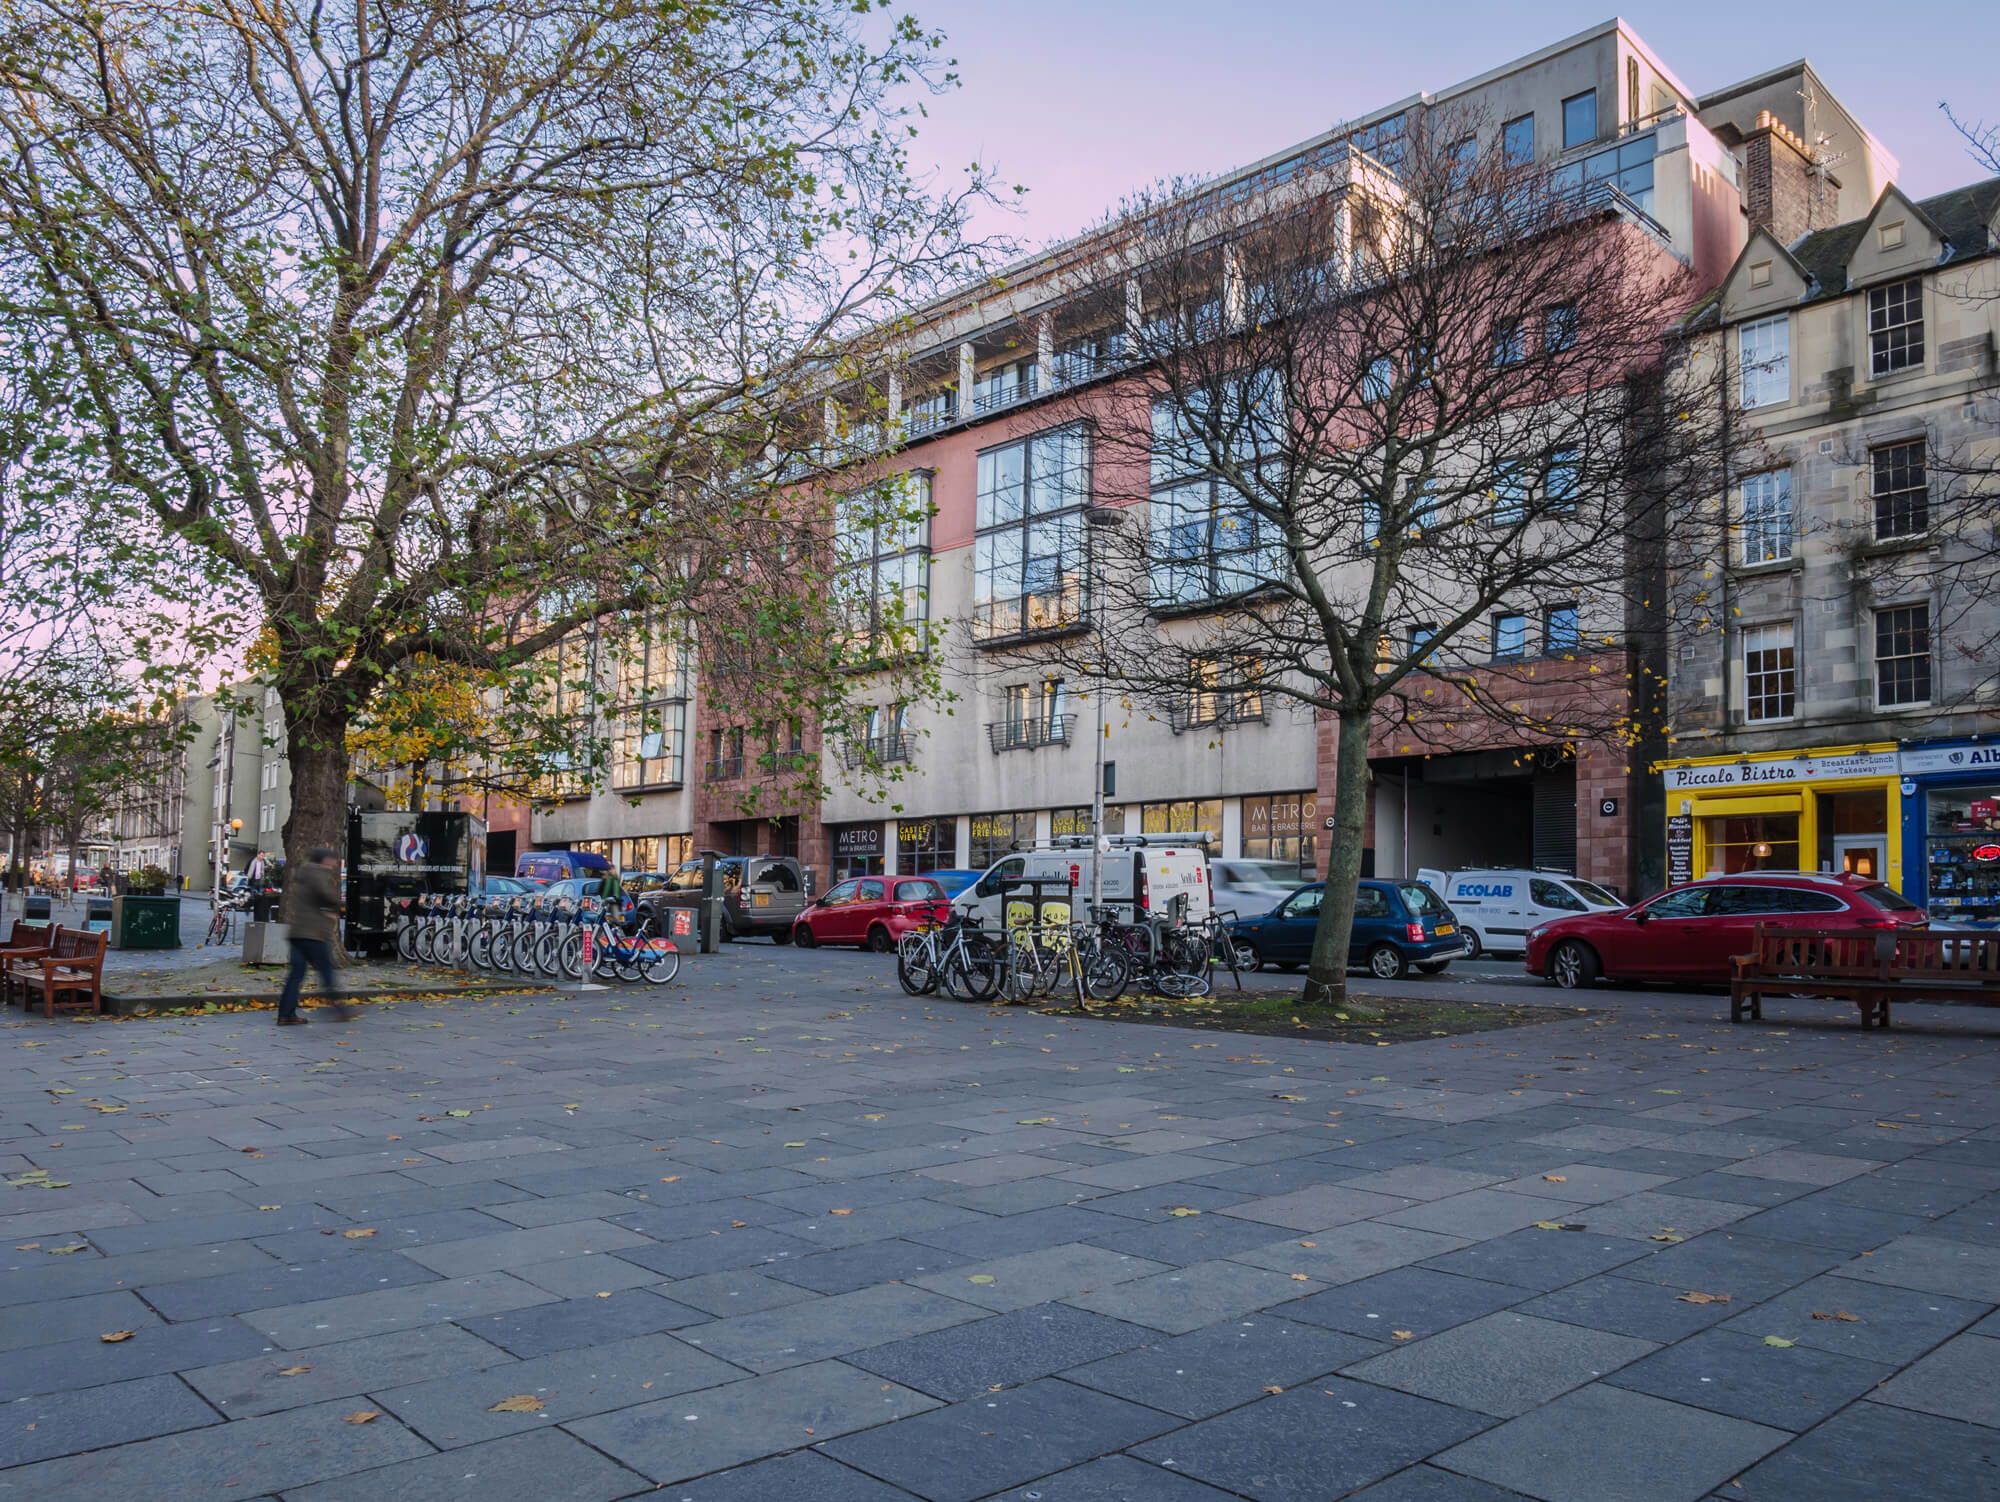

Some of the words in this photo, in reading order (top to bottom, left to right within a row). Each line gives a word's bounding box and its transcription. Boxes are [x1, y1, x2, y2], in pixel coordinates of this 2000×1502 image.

[1839, 766, 1877, 774] Takeaway
[1676, 768, 1735, 786] Piccolo
[1741, 765, 1796, 781] Bistro
[1252, 802, 1316, 821] METRO
[972, 821, 1001, 829] FAMILY
[1053, 816, 1081, 825] LOCAL
[899, 825, 927, 834] CASTLE
[1053, 824, 1086, 834] DISHES
[1251, 823, 1267, 833] BAR
[1277, 821, 1317, 831] BRASSERIE
[839, 829, 878, 843] METRO
[899, 832, 922, 841] VIEWS
[972, 828, 1012, 838] FRIENDLY
[1457, 884, 1512, 897] ECOLAB
